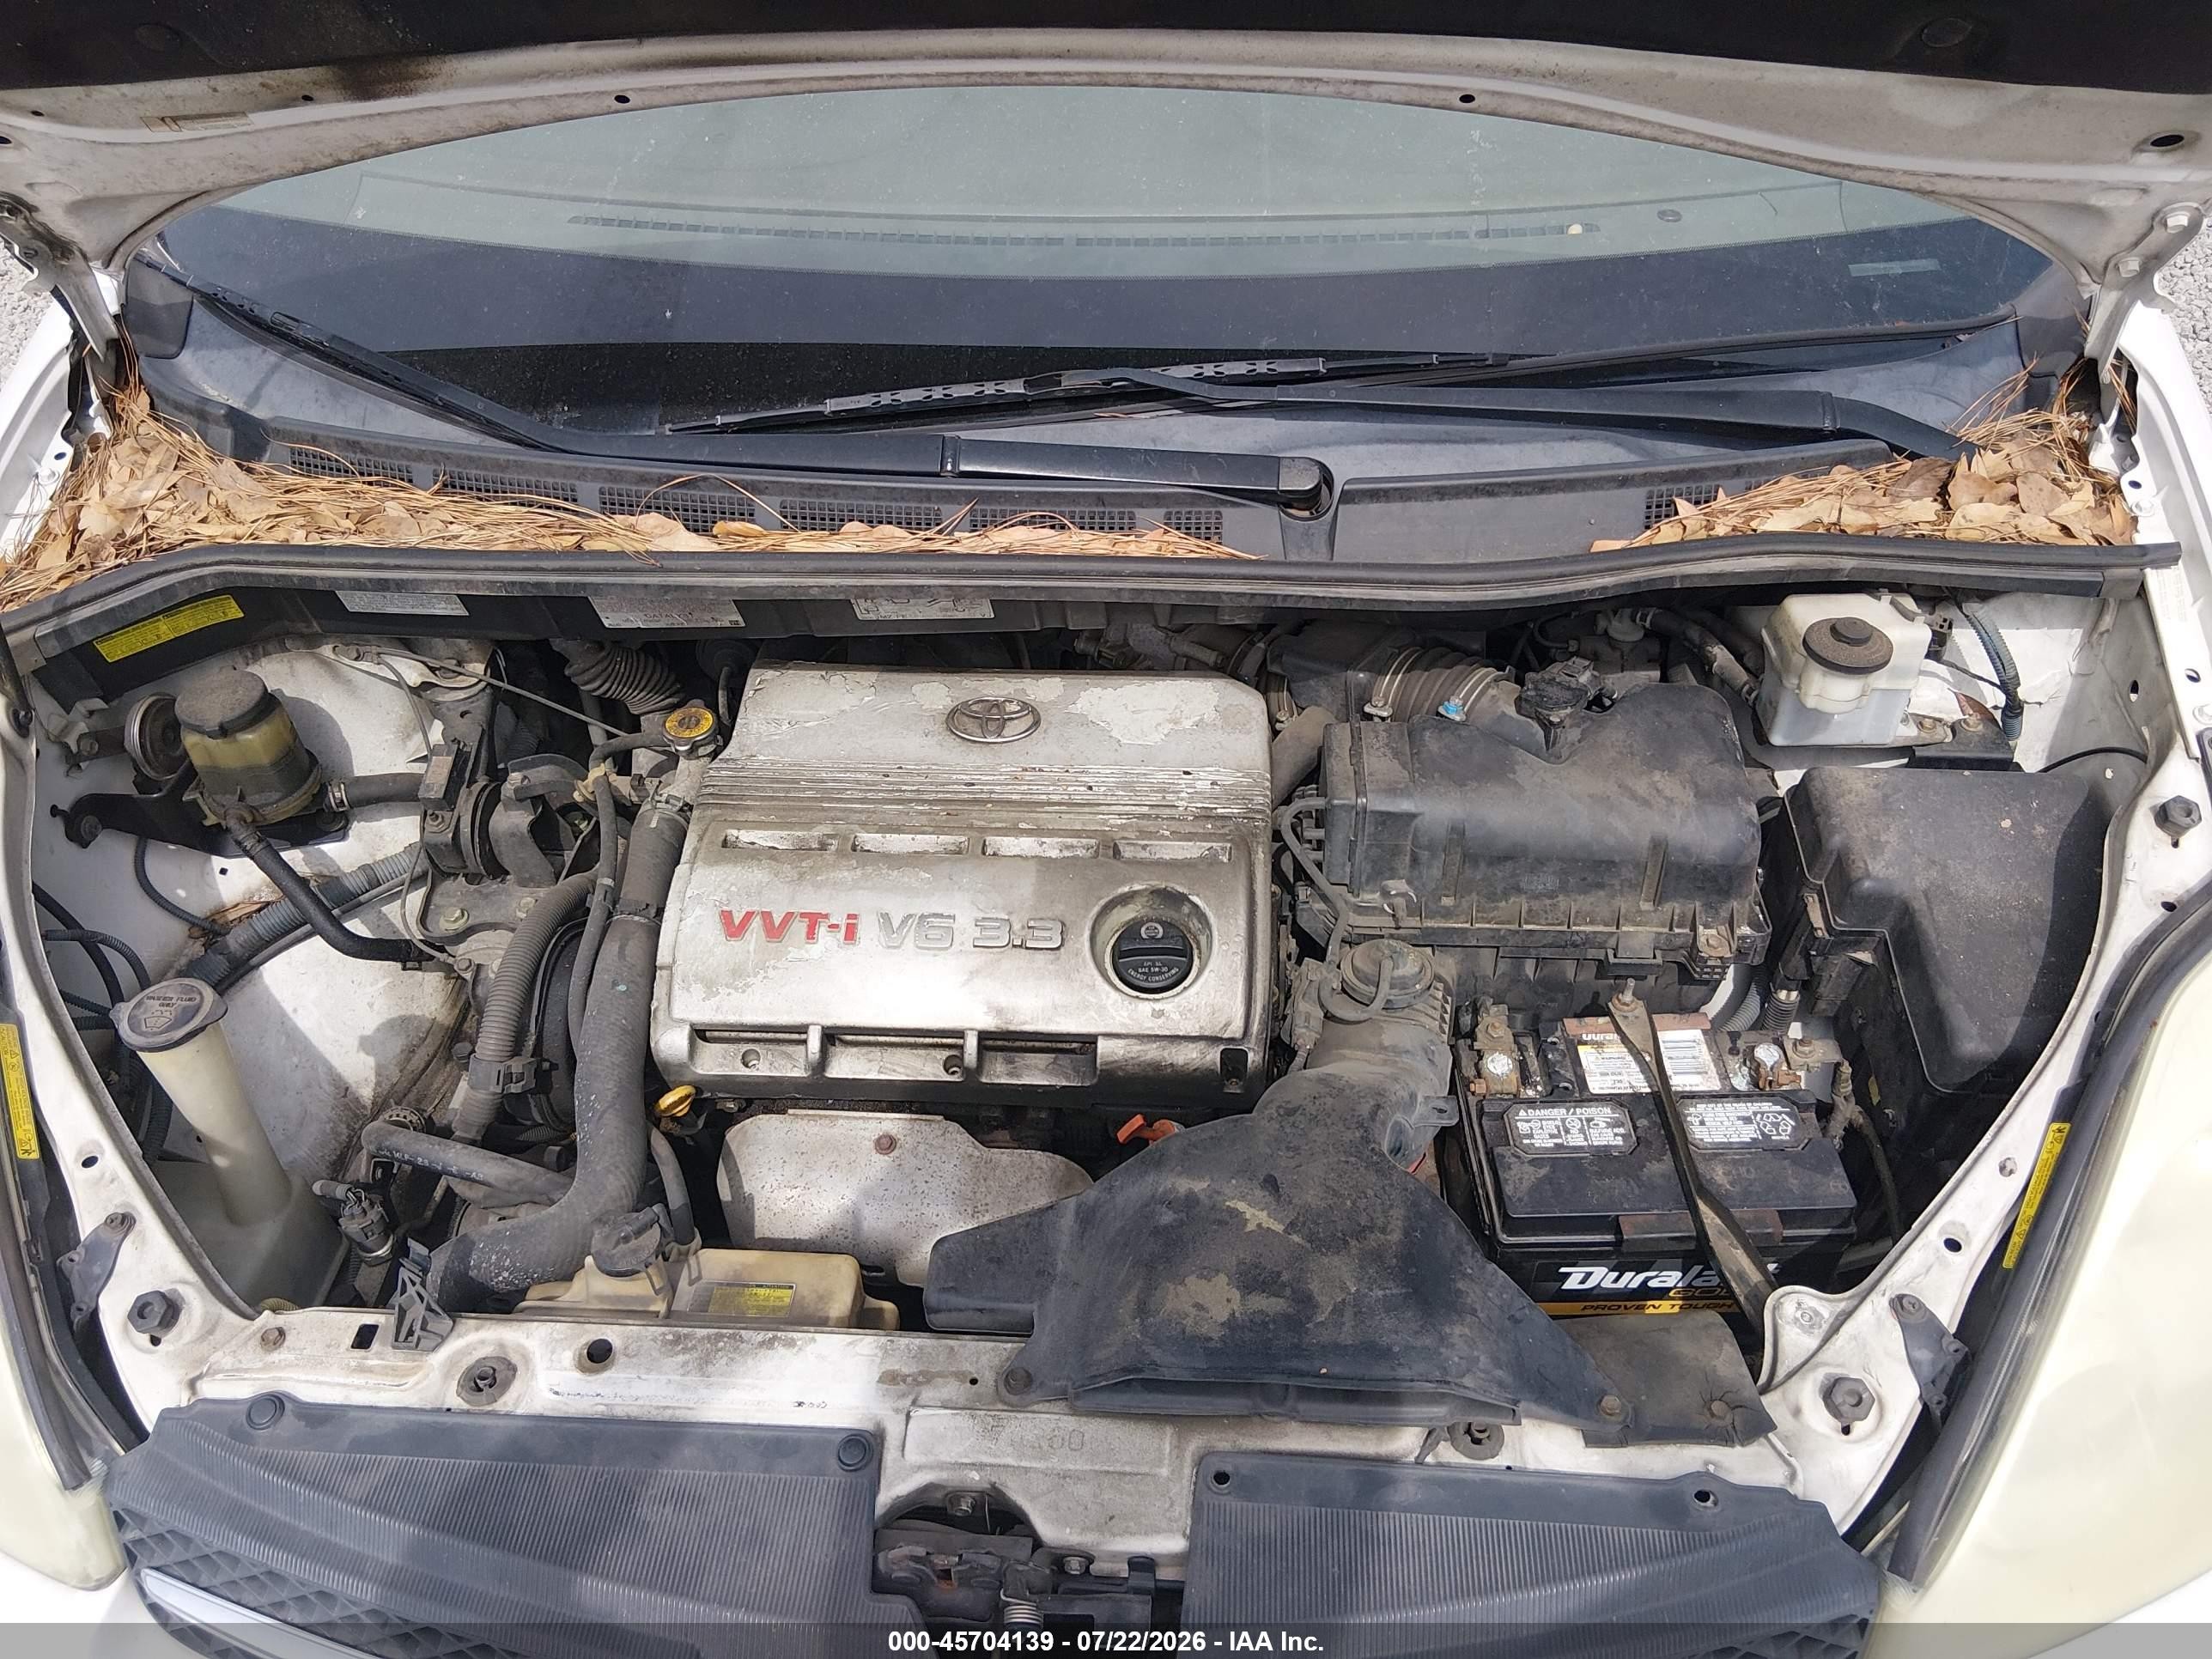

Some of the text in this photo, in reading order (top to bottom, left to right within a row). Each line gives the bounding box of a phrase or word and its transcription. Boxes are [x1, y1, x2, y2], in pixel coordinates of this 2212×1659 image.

[719, 909, 1066, 951] VVT-i V6 3.3
[1576, 1106, 1613, 1115] POISON
